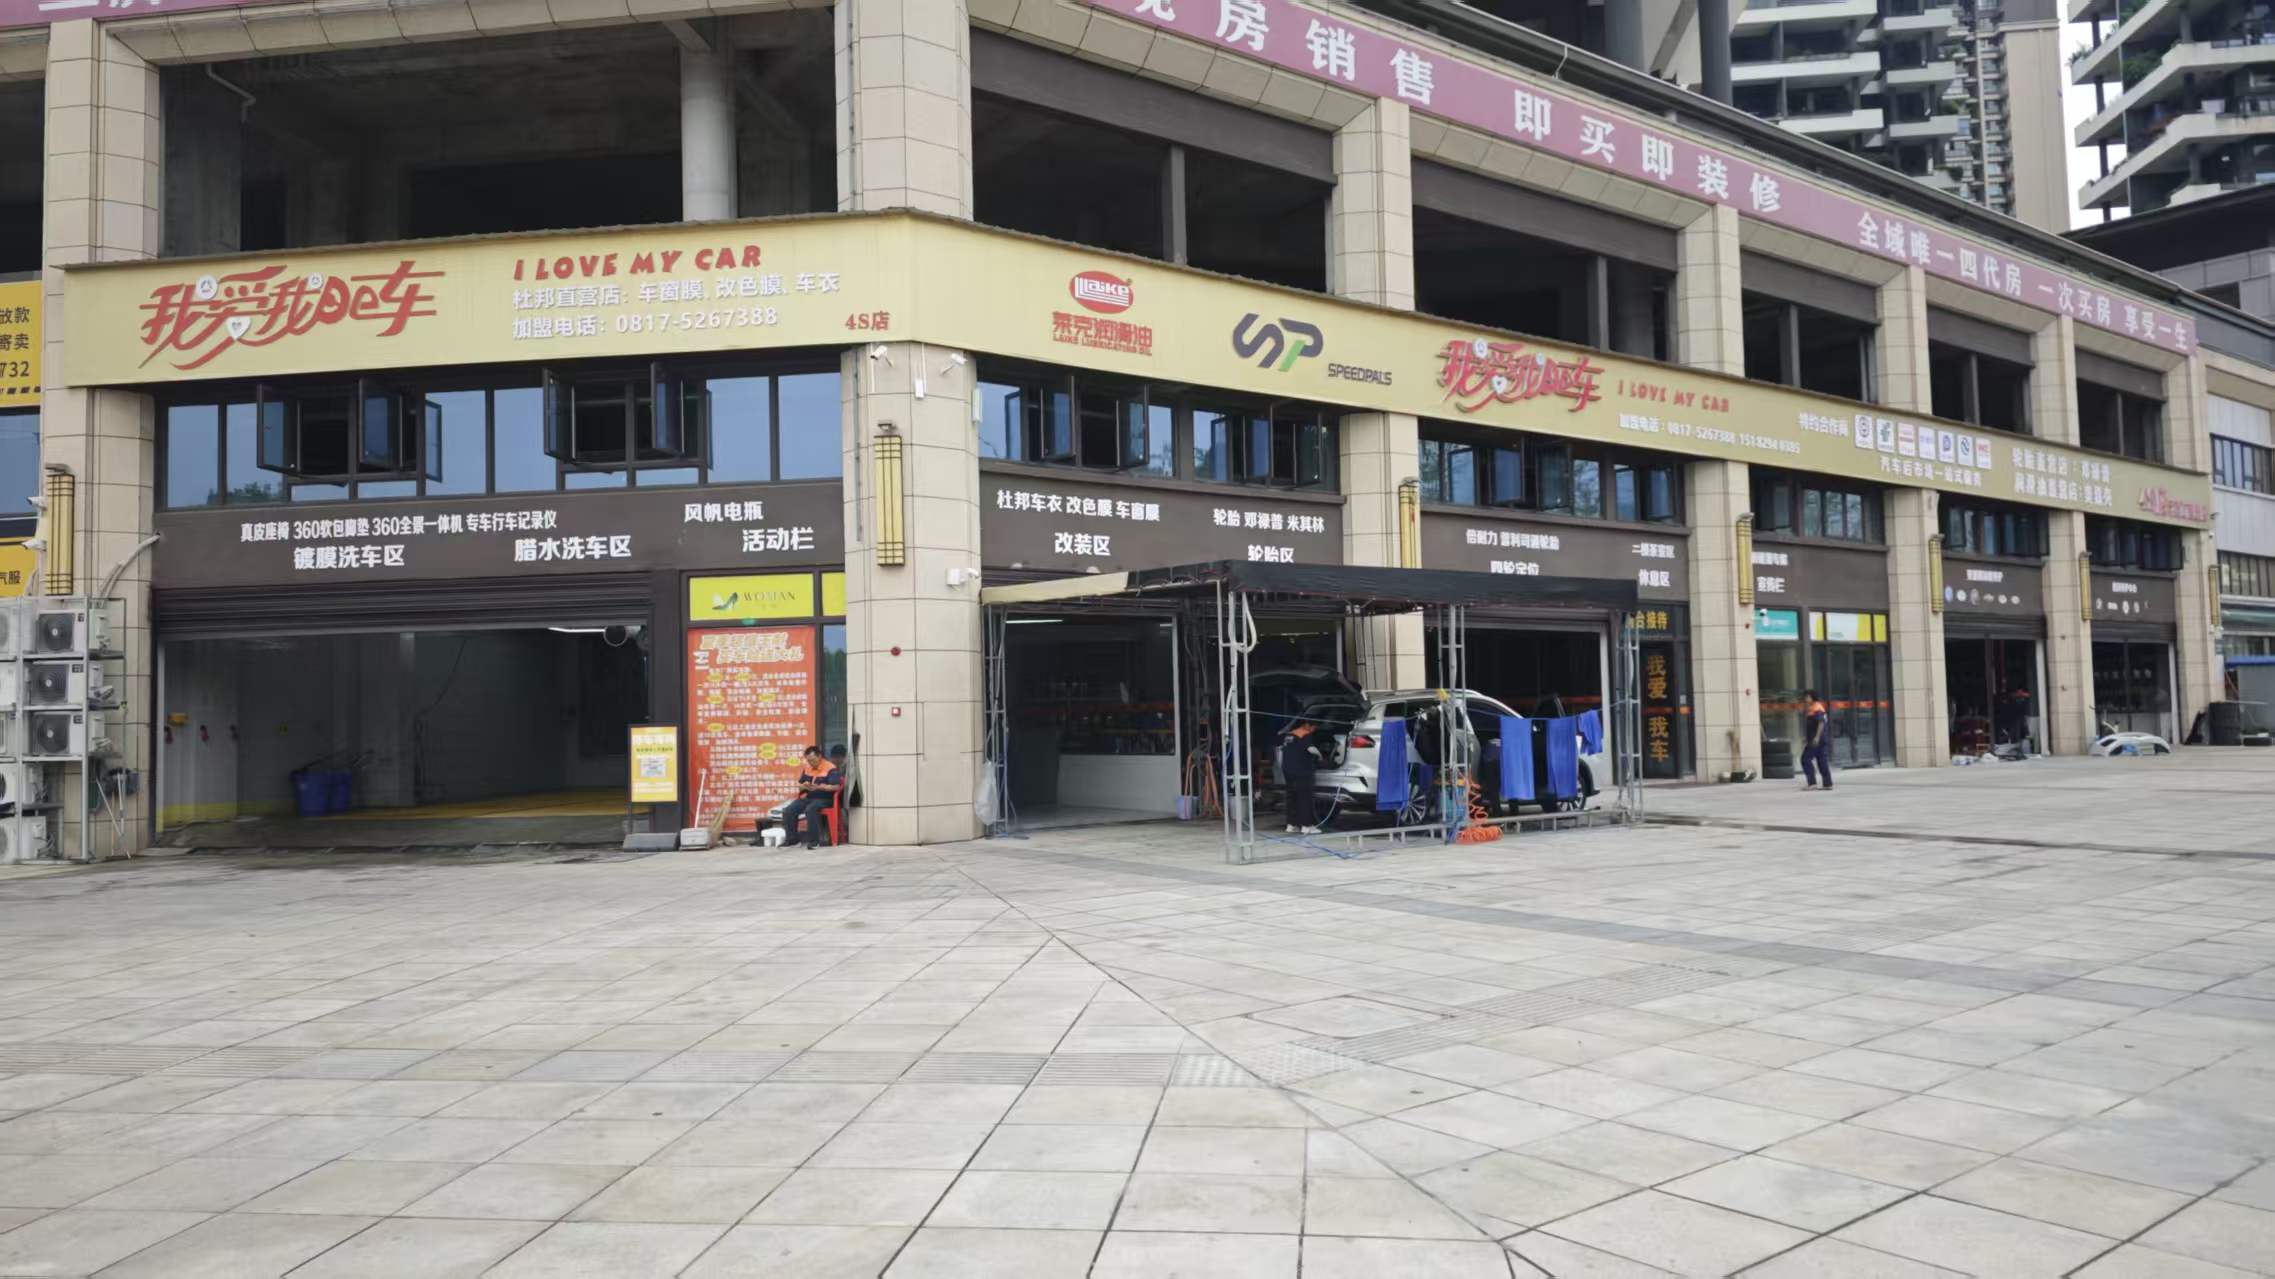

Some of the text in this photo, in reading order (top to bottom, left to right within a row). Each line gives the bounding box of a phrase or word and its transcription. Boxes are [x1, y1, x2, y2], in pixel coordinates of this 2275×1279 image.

[1513, 91, 1781, 212] 即买即装修
[1857, 211, 2022, 297] 全域唯一四代房
[2038, 282, 2111, 326] 一次买房
[2124, 303, 2188, 351] 享受一生
[513, 245, 761, 281] I LOVE MY CAR
[616, 307, 779, 335] 0817-5267388
[845, 311, 890, 332] 4S店
[1052, 311, 1152, 348] 莱克润滑油
[1328, 363, 1393, 386] SPEEDPALS
[1629, 382, 1667, 403] LOVE
[1674, 388, 1695, 407] MY
[1702, 394, 1730, 413] CAR
[684, 501, 764, 523] 风帆电瓶
[996, 489, 1062, 513] 杜邦车衣
[1066, 496, 1112, 517] 改色膜
[240, 521, 289, 543] 真皮座椅
[372, 513, 463, 537] 360全景一体机
[466, 510, 558, 532] 专车行车记录仪
[1213, 508, 1325, 533] 轮胎 邓禄普 米其林
[742, 527, 815, 552] 活动栏
[1054, 532, 1111, 557] 改装区
[294, 544, 405, 570] 镀膜洗车区
[1247, 544, 1295, 564] 轮胎区
